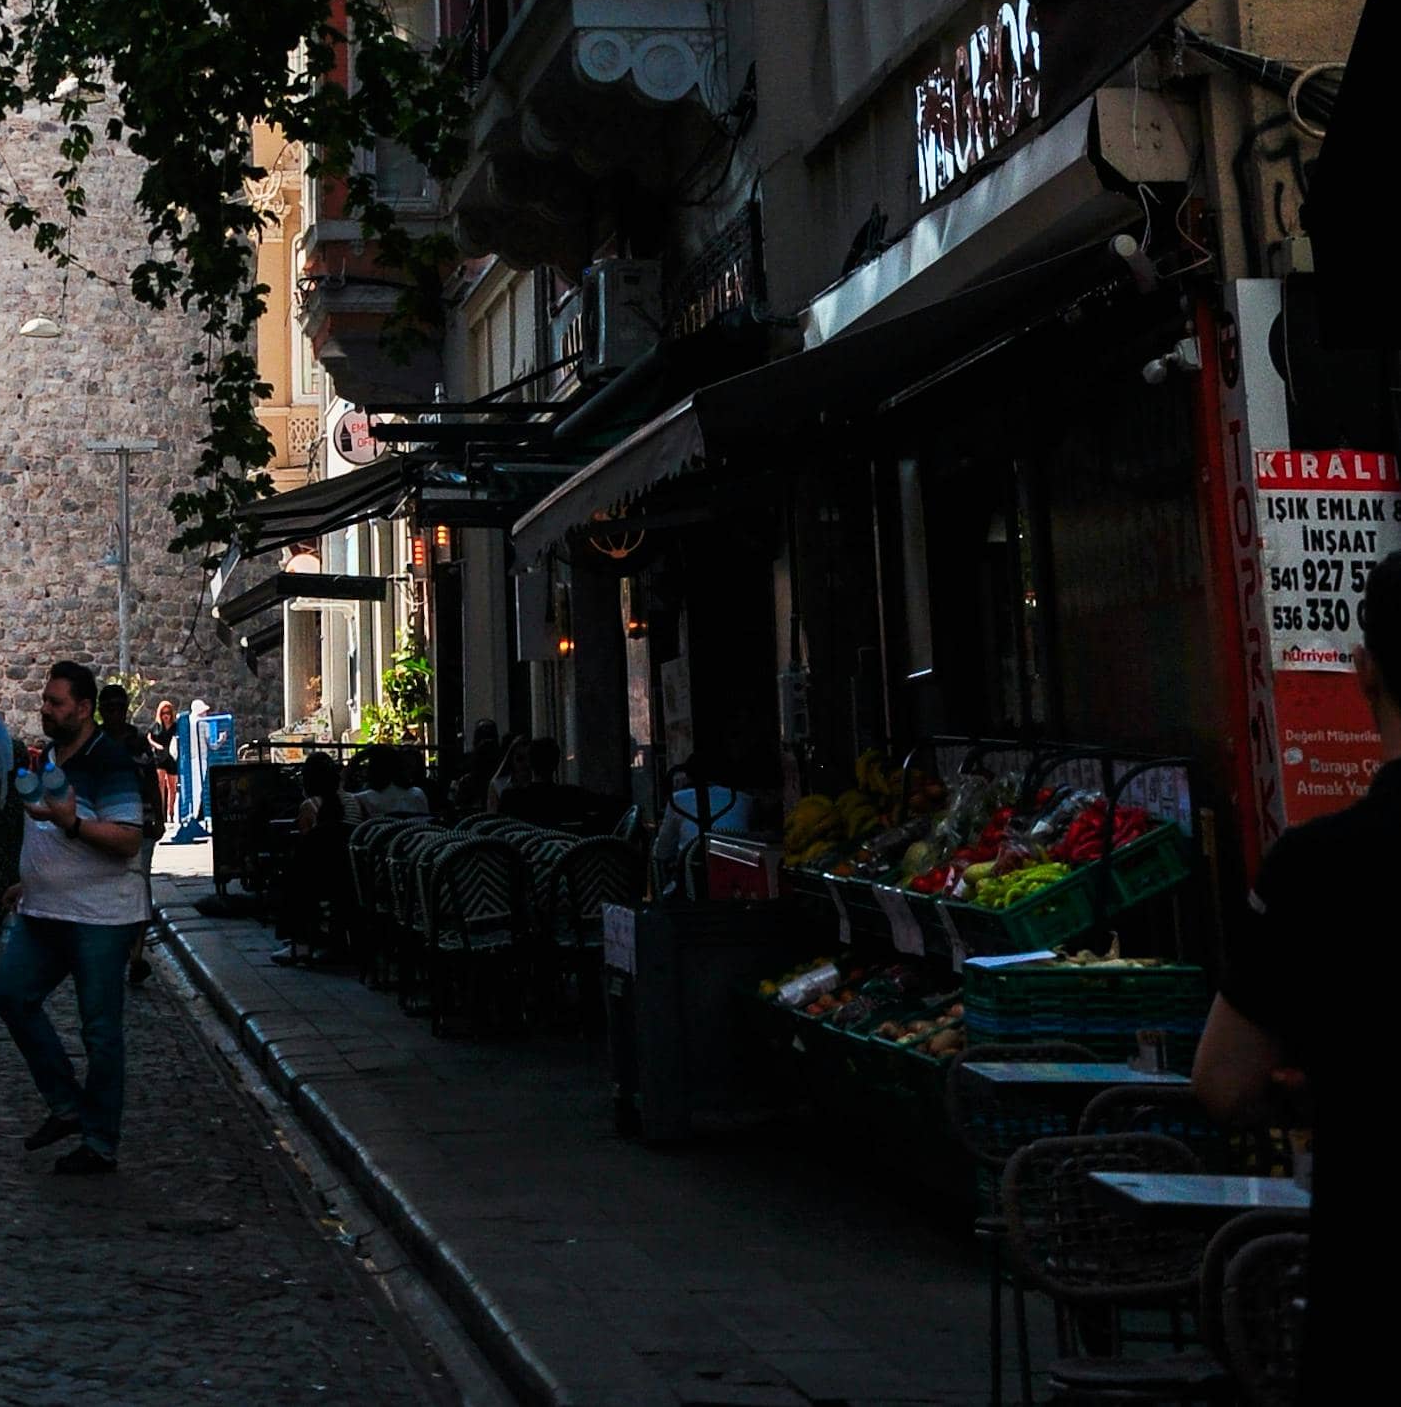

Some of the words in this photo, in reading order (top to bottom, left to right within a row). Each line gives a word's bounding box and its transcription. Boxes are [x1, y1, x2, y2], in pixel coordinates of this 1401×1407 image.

[1268, 497, 1309, 522] IŞIK
[1317, 497, 1385, 521] EMLAK
[1302, 525, 1376, 555] İNŞAAT
[1271, 567, 1299, 591] 541
[1303, 559, 1343, 591] 927
[1273, 606, 1302, 630] 536
[1306, 598, 1349, 631] 330
[1310, 757, 1358, 778] Buraya
[1297, 779, 1343, 795] Atmak
